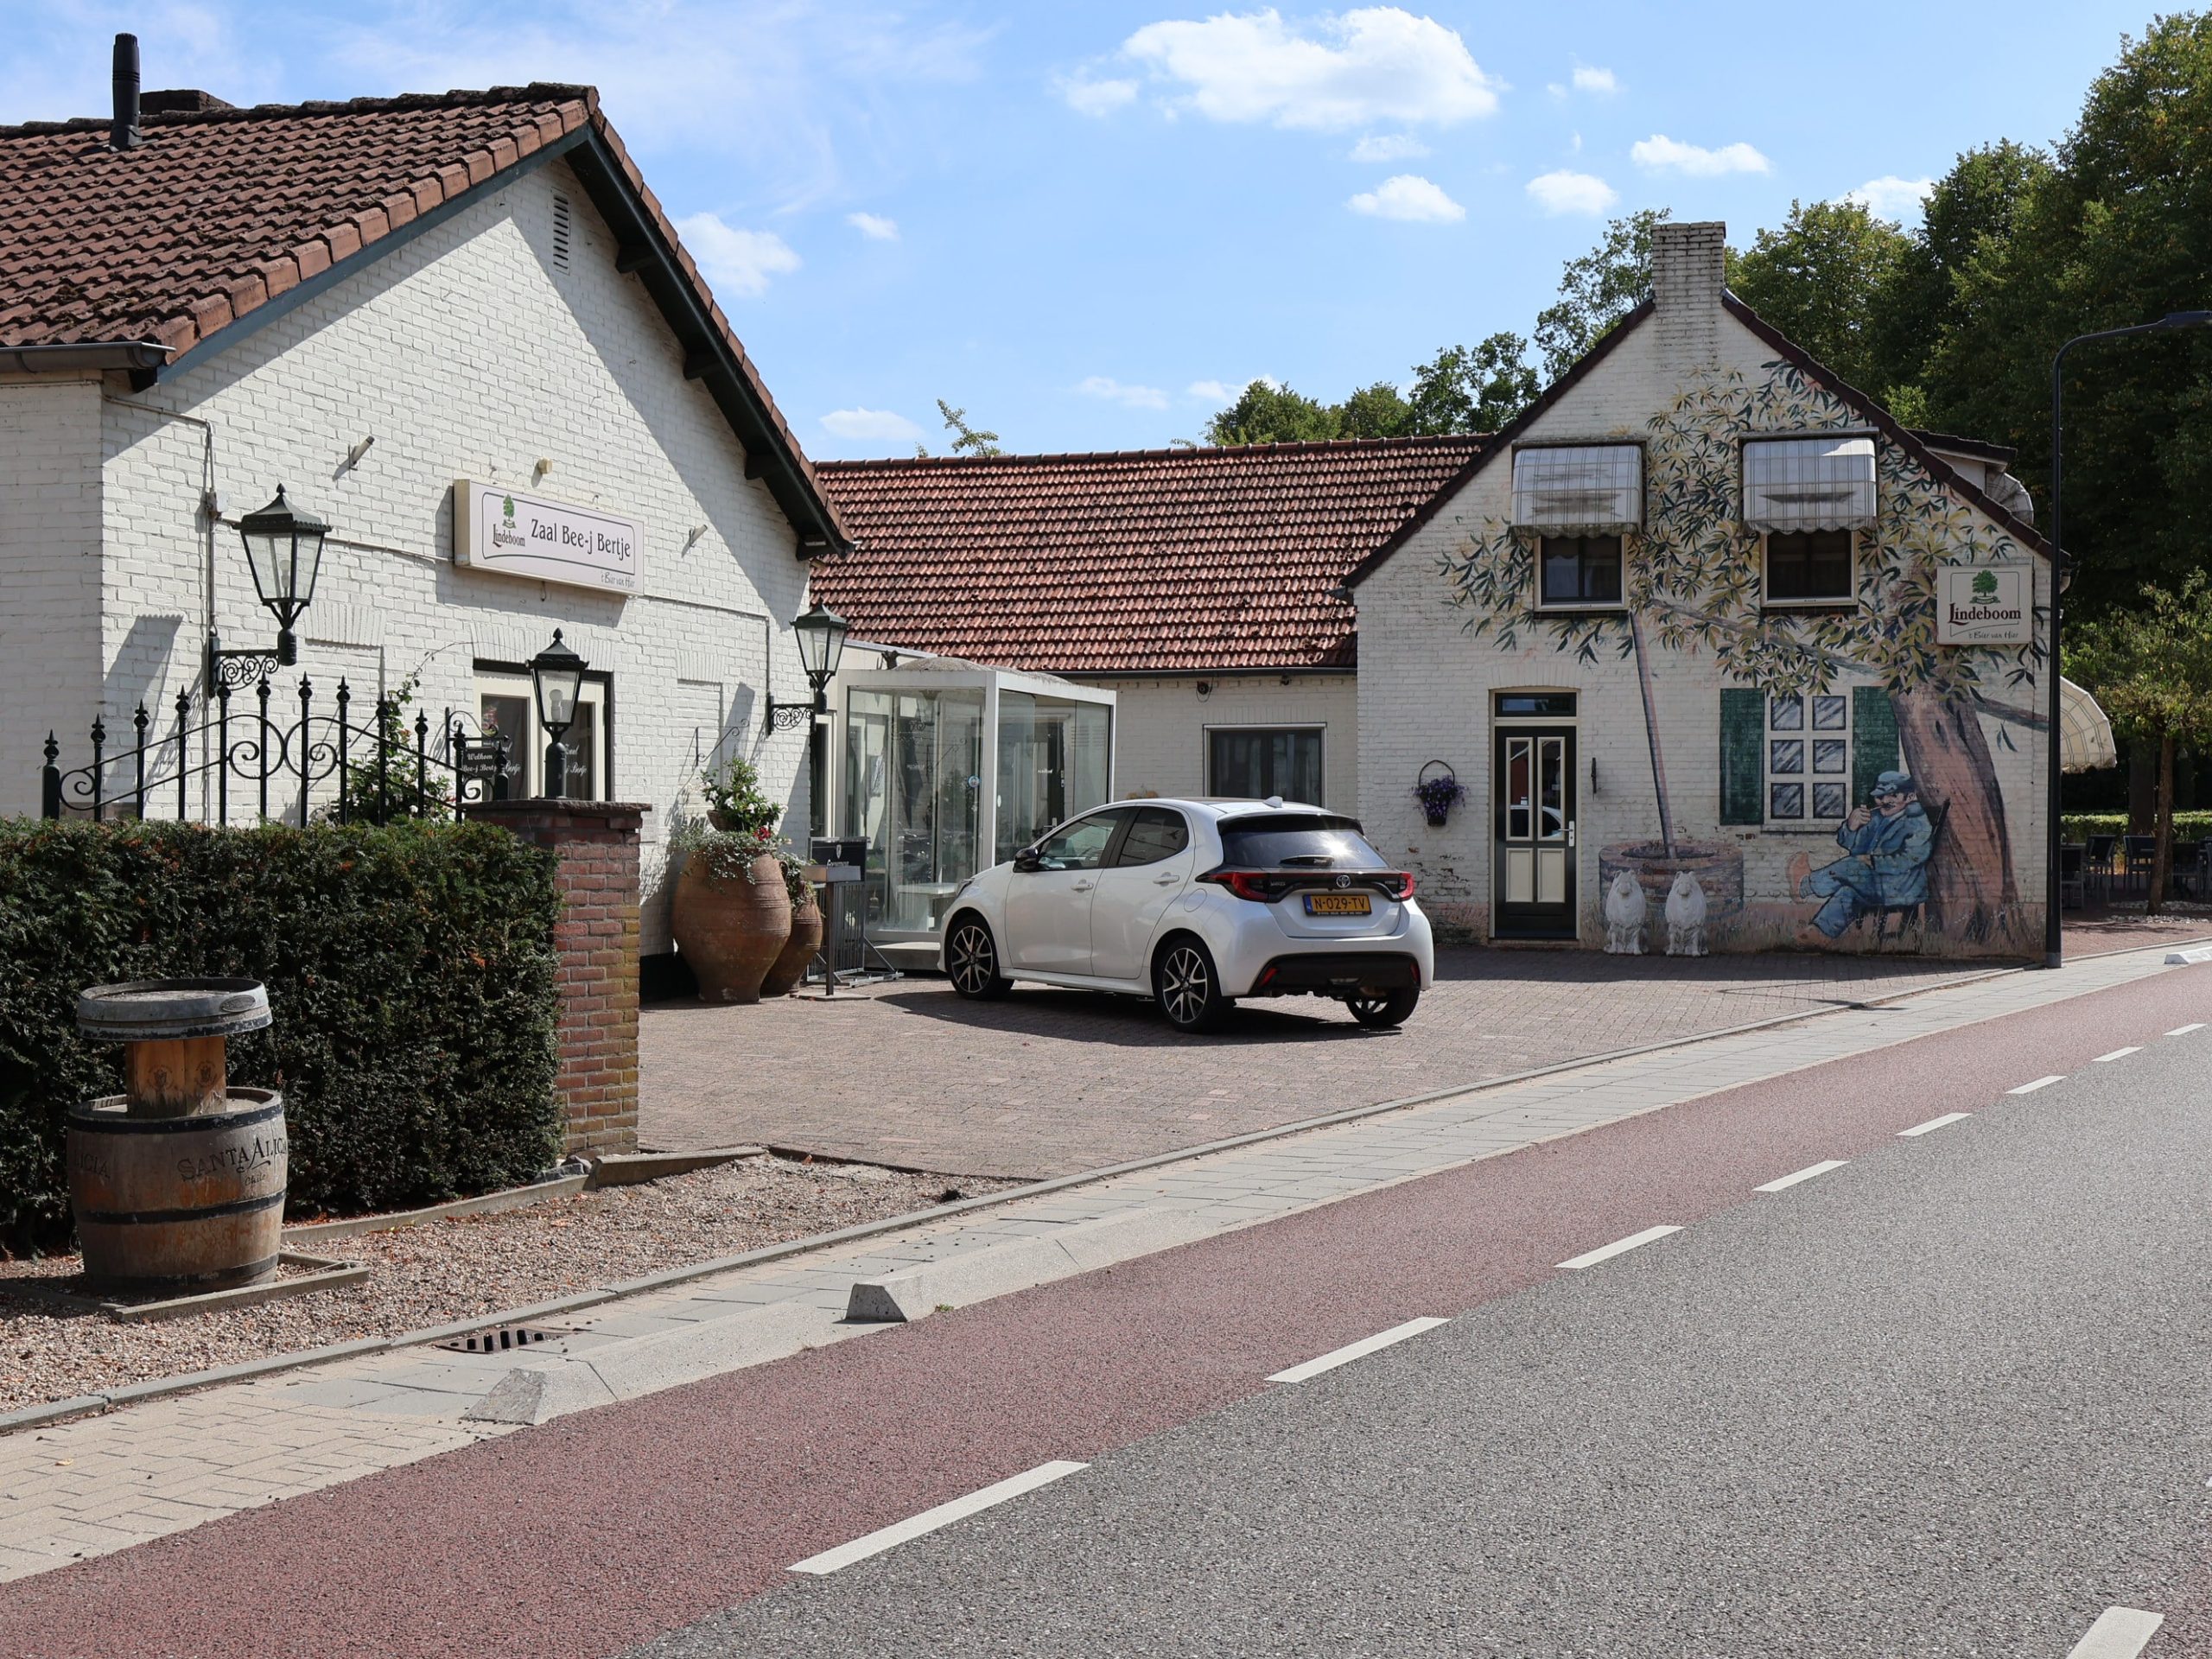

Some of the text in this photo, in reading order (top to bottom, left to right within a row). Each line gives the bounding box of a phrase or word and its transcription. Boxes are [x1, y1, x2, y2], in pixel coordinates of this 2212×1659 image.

[492, 524, 525, 548] Lindeboom
[531, 518, 631, 562] Zaal Bee-j Bertje
[1948, 602, 2022, 626] Lindeboom
[467, 752, 493, 760] Welkom
[1313, 897, 1365, 910] N-029-TV
[177, 1147, 250, 1182] SANTA
